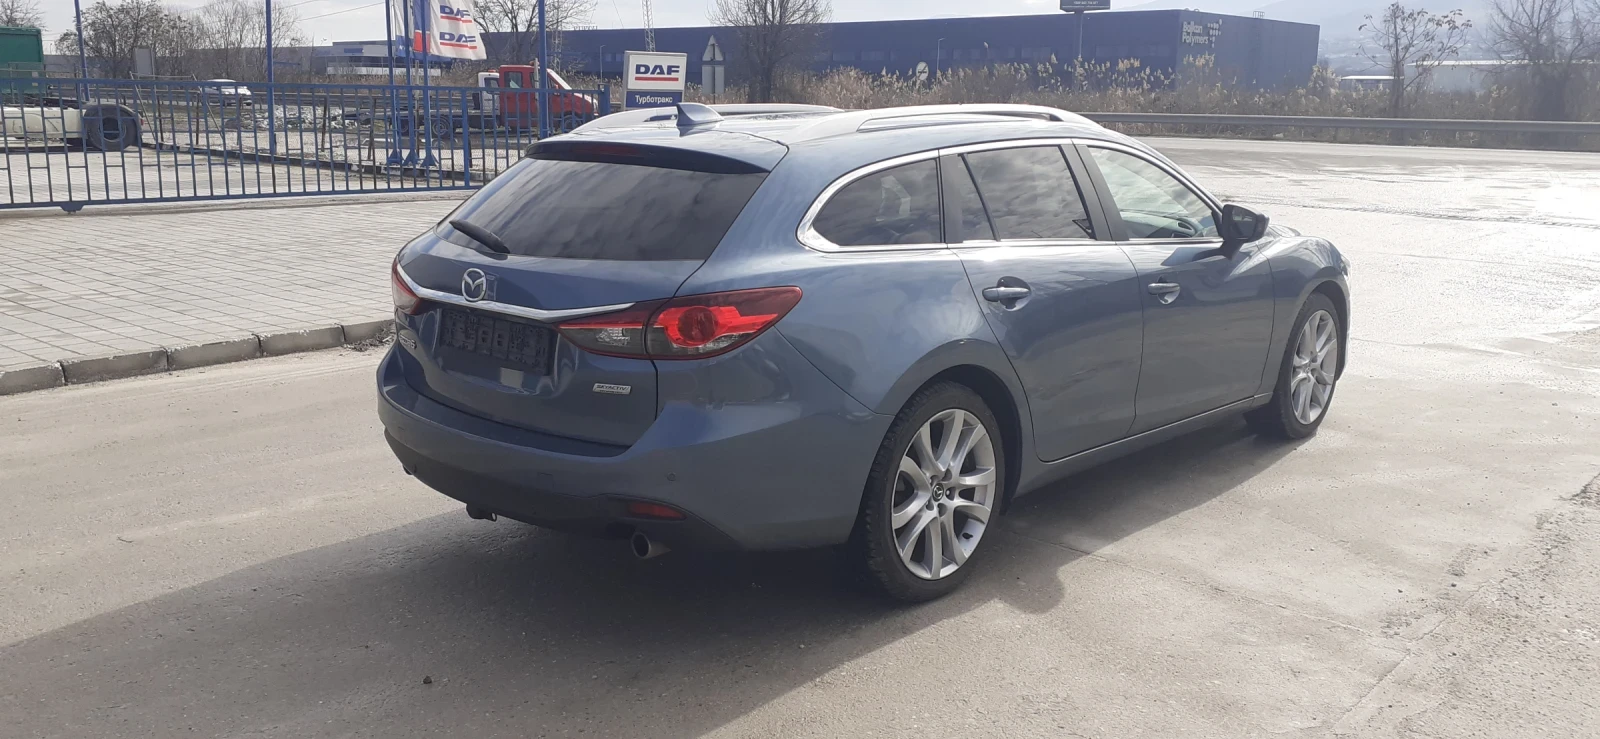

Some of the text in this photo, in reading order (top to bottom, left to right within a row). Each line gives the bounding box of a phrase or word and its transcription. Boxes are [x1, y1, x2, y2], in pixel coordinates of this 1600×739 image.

[440, 5, 470, 18] DAF
[1183, 21, 1203, 33] Balkan
[440, 32, 476, 43] DAF
[1182, 32, 1208, 46] Polymers
[635, 64, 680, 75] DAF
[635, 94, 673, 104] Турботракс
